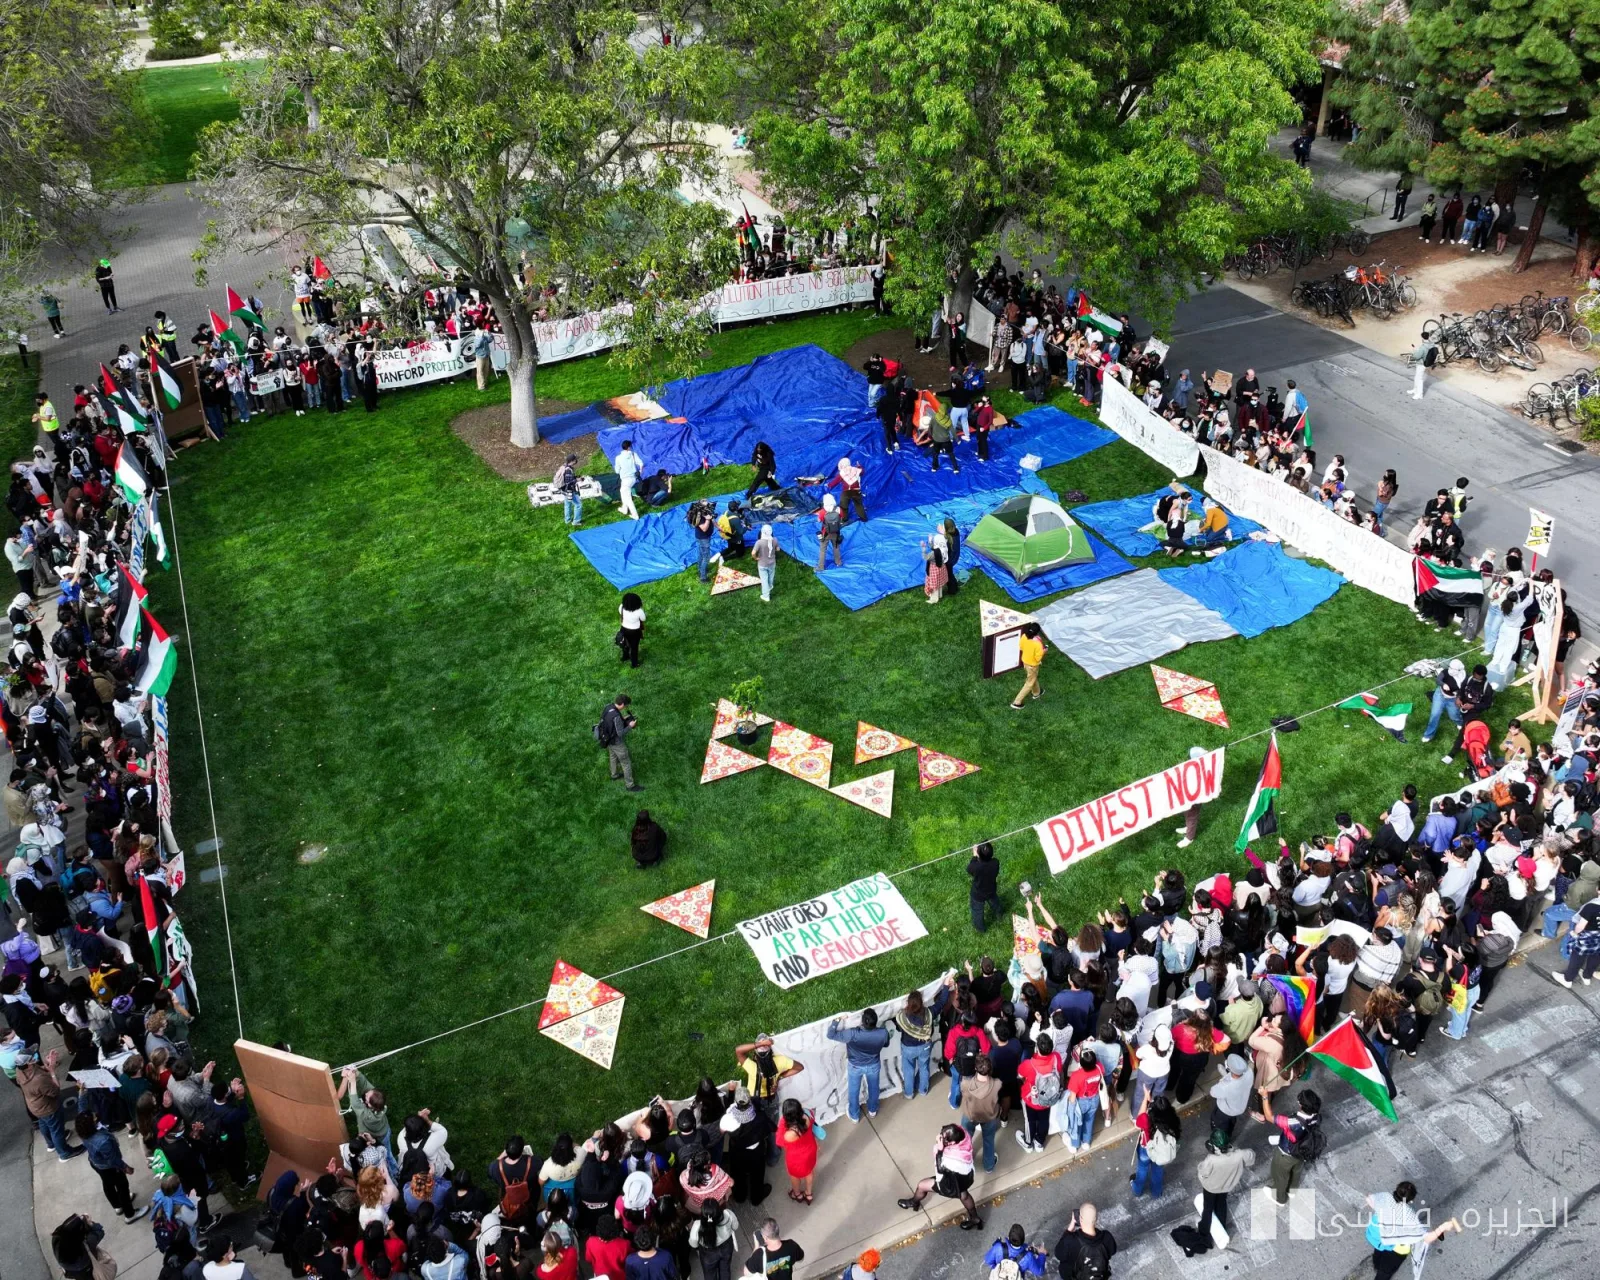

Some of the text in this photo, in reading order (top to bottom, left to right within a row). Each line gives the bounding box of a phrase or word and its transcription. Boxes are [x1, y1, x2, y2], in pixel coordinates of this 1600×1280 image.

[765, 275, 804, 297] THERE'S
[373, 350, 407, 361] SRAEL
[378, 356, 464, 384] TANFORD PROFITS
[1048, 753, 1217, 862] DIVEST NOW
[742, 874, 892, 940] STANFORD FUNDS
[772, 901, 886, 959] APARTHEID
[772, 917, 911, 984] AND GENOCIDE
